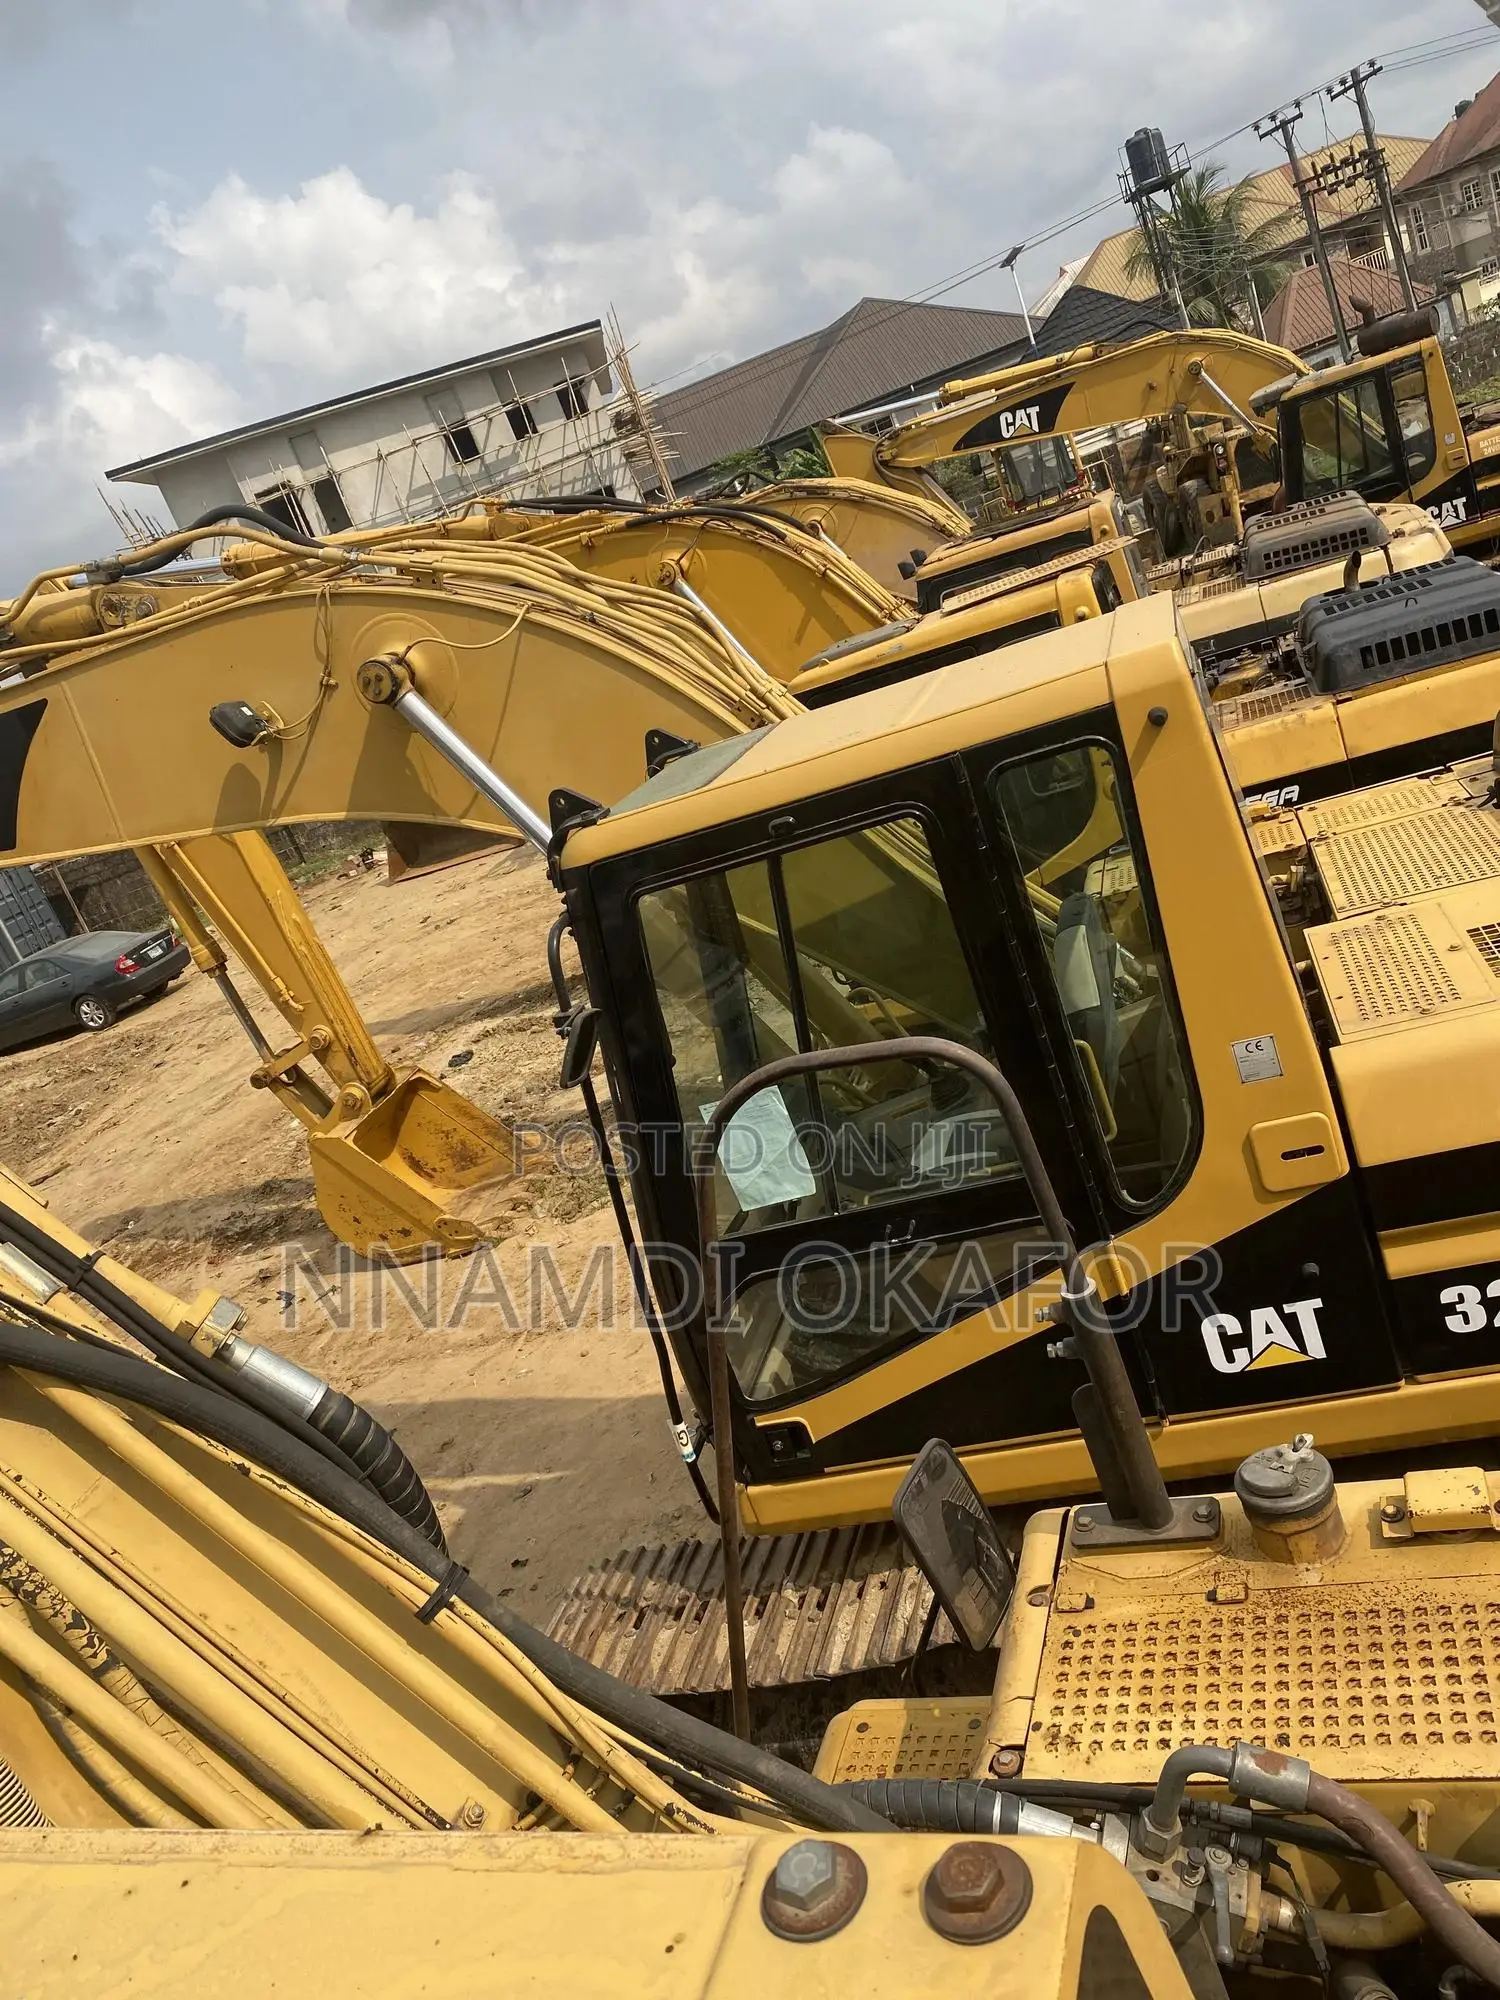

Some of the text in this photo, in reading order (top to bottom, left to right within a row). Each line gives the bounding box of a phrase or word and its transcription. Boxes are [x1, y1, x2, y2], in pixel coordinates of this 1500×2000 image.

[1000, 406, 1039, 439] CAT
[1426, 496, 1466, 525] CAT
[1245, 1040, 1264, 1054] CE
[1439, 1280, 1500, 1333] 3
[1201, 1297, 1327, 1373] CAT
